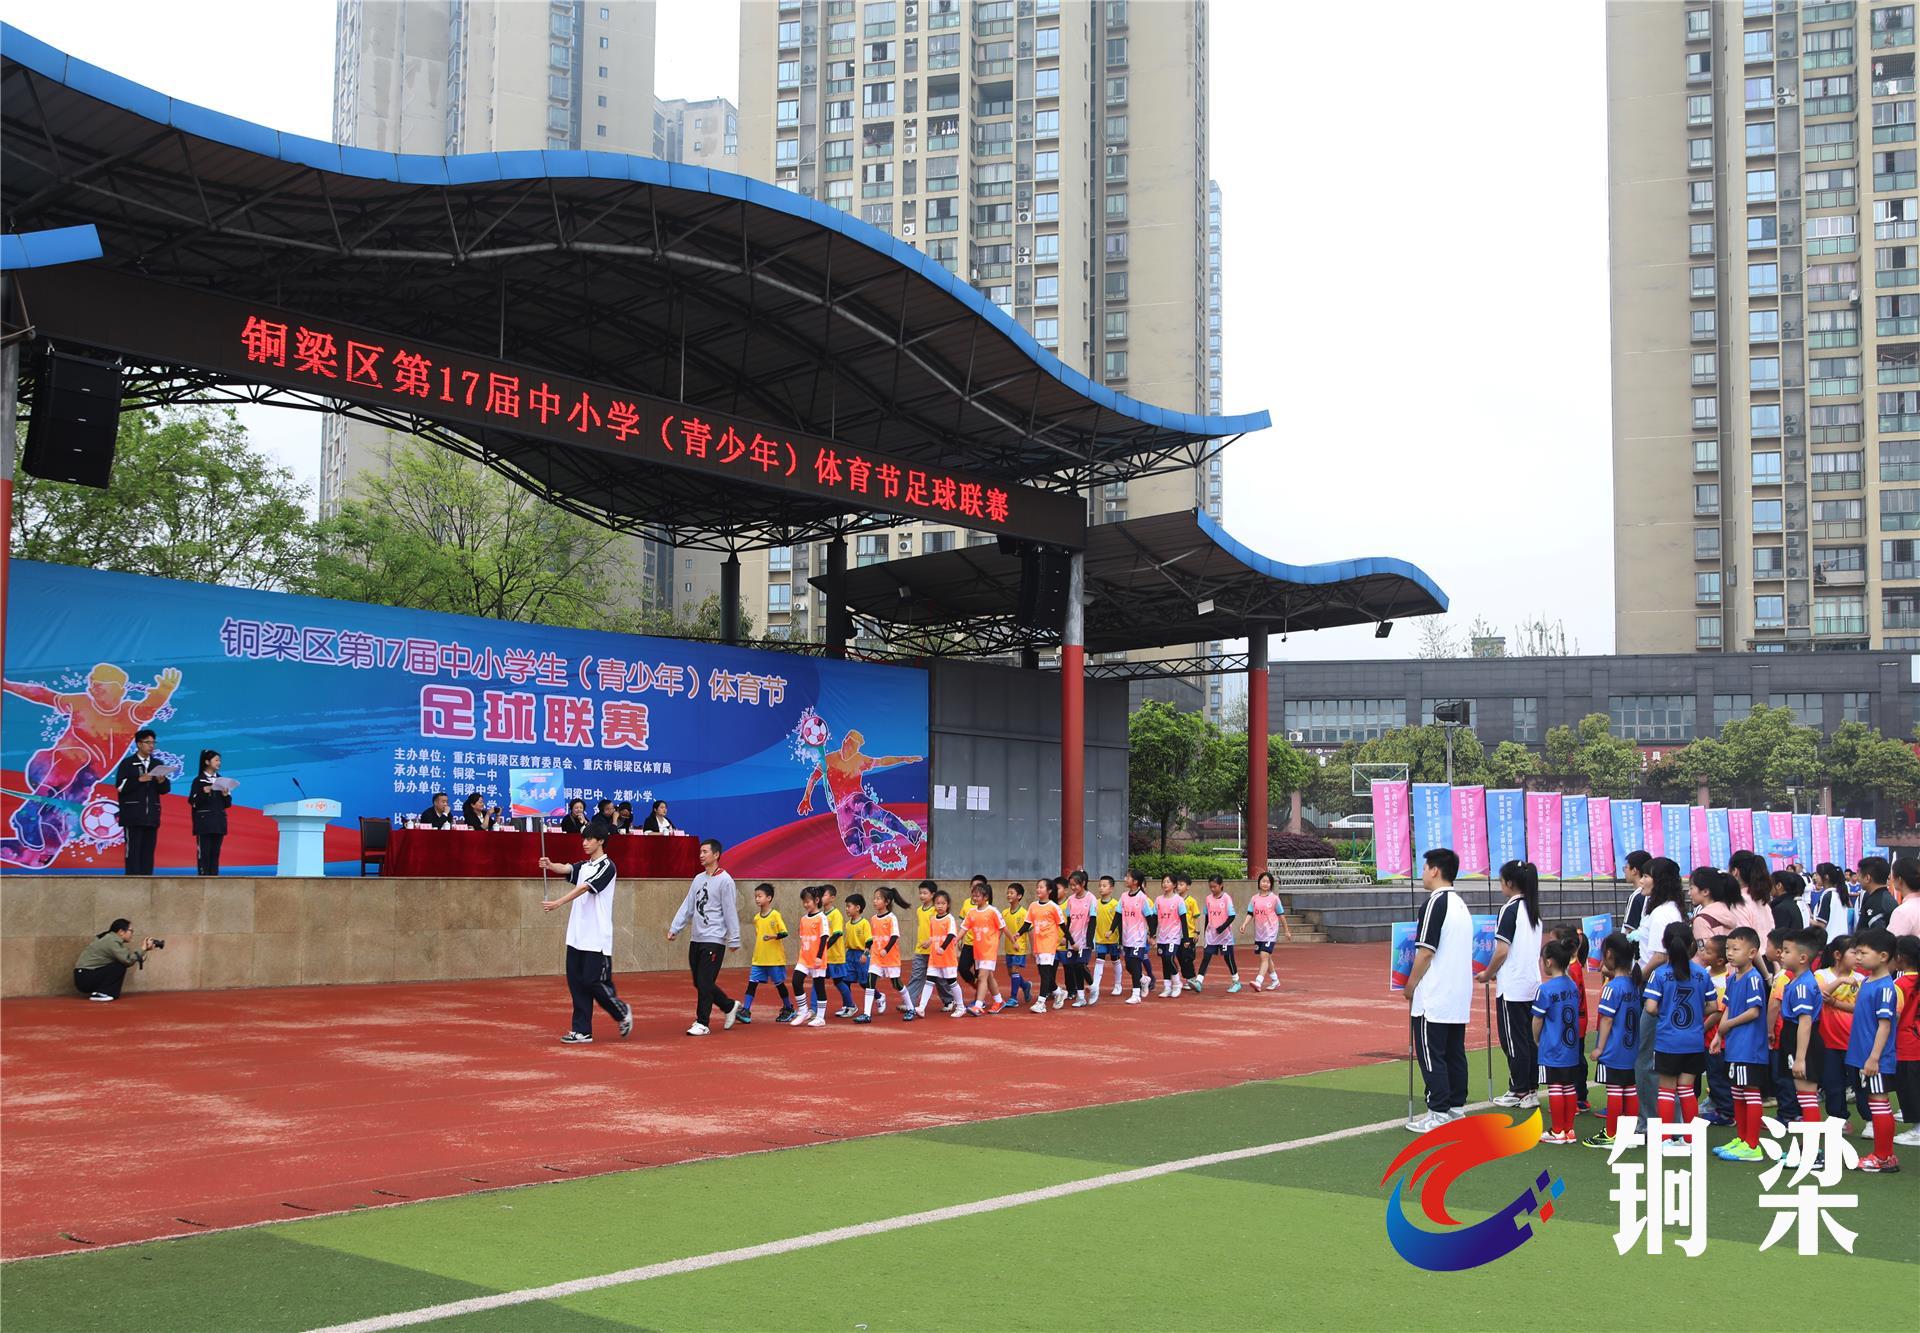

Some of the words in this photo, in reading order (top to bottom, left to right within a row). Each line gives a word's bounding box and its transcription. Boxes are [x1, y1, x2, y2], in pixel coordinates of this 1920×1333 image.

[241, 315, 1009, 523] 铜梁区第17届中小学（青少年）体育节足球联赛
[219, 616, 787, 707] 铜梁区第17届中小学生（青少年）体育节
[420, 684, 649, 751] 足球联赛
[1561, 1003, 1577, 1048] 8
[1622, 1006, 1637, 1049] 9
[1671, 986, 1694, 1030] 3
